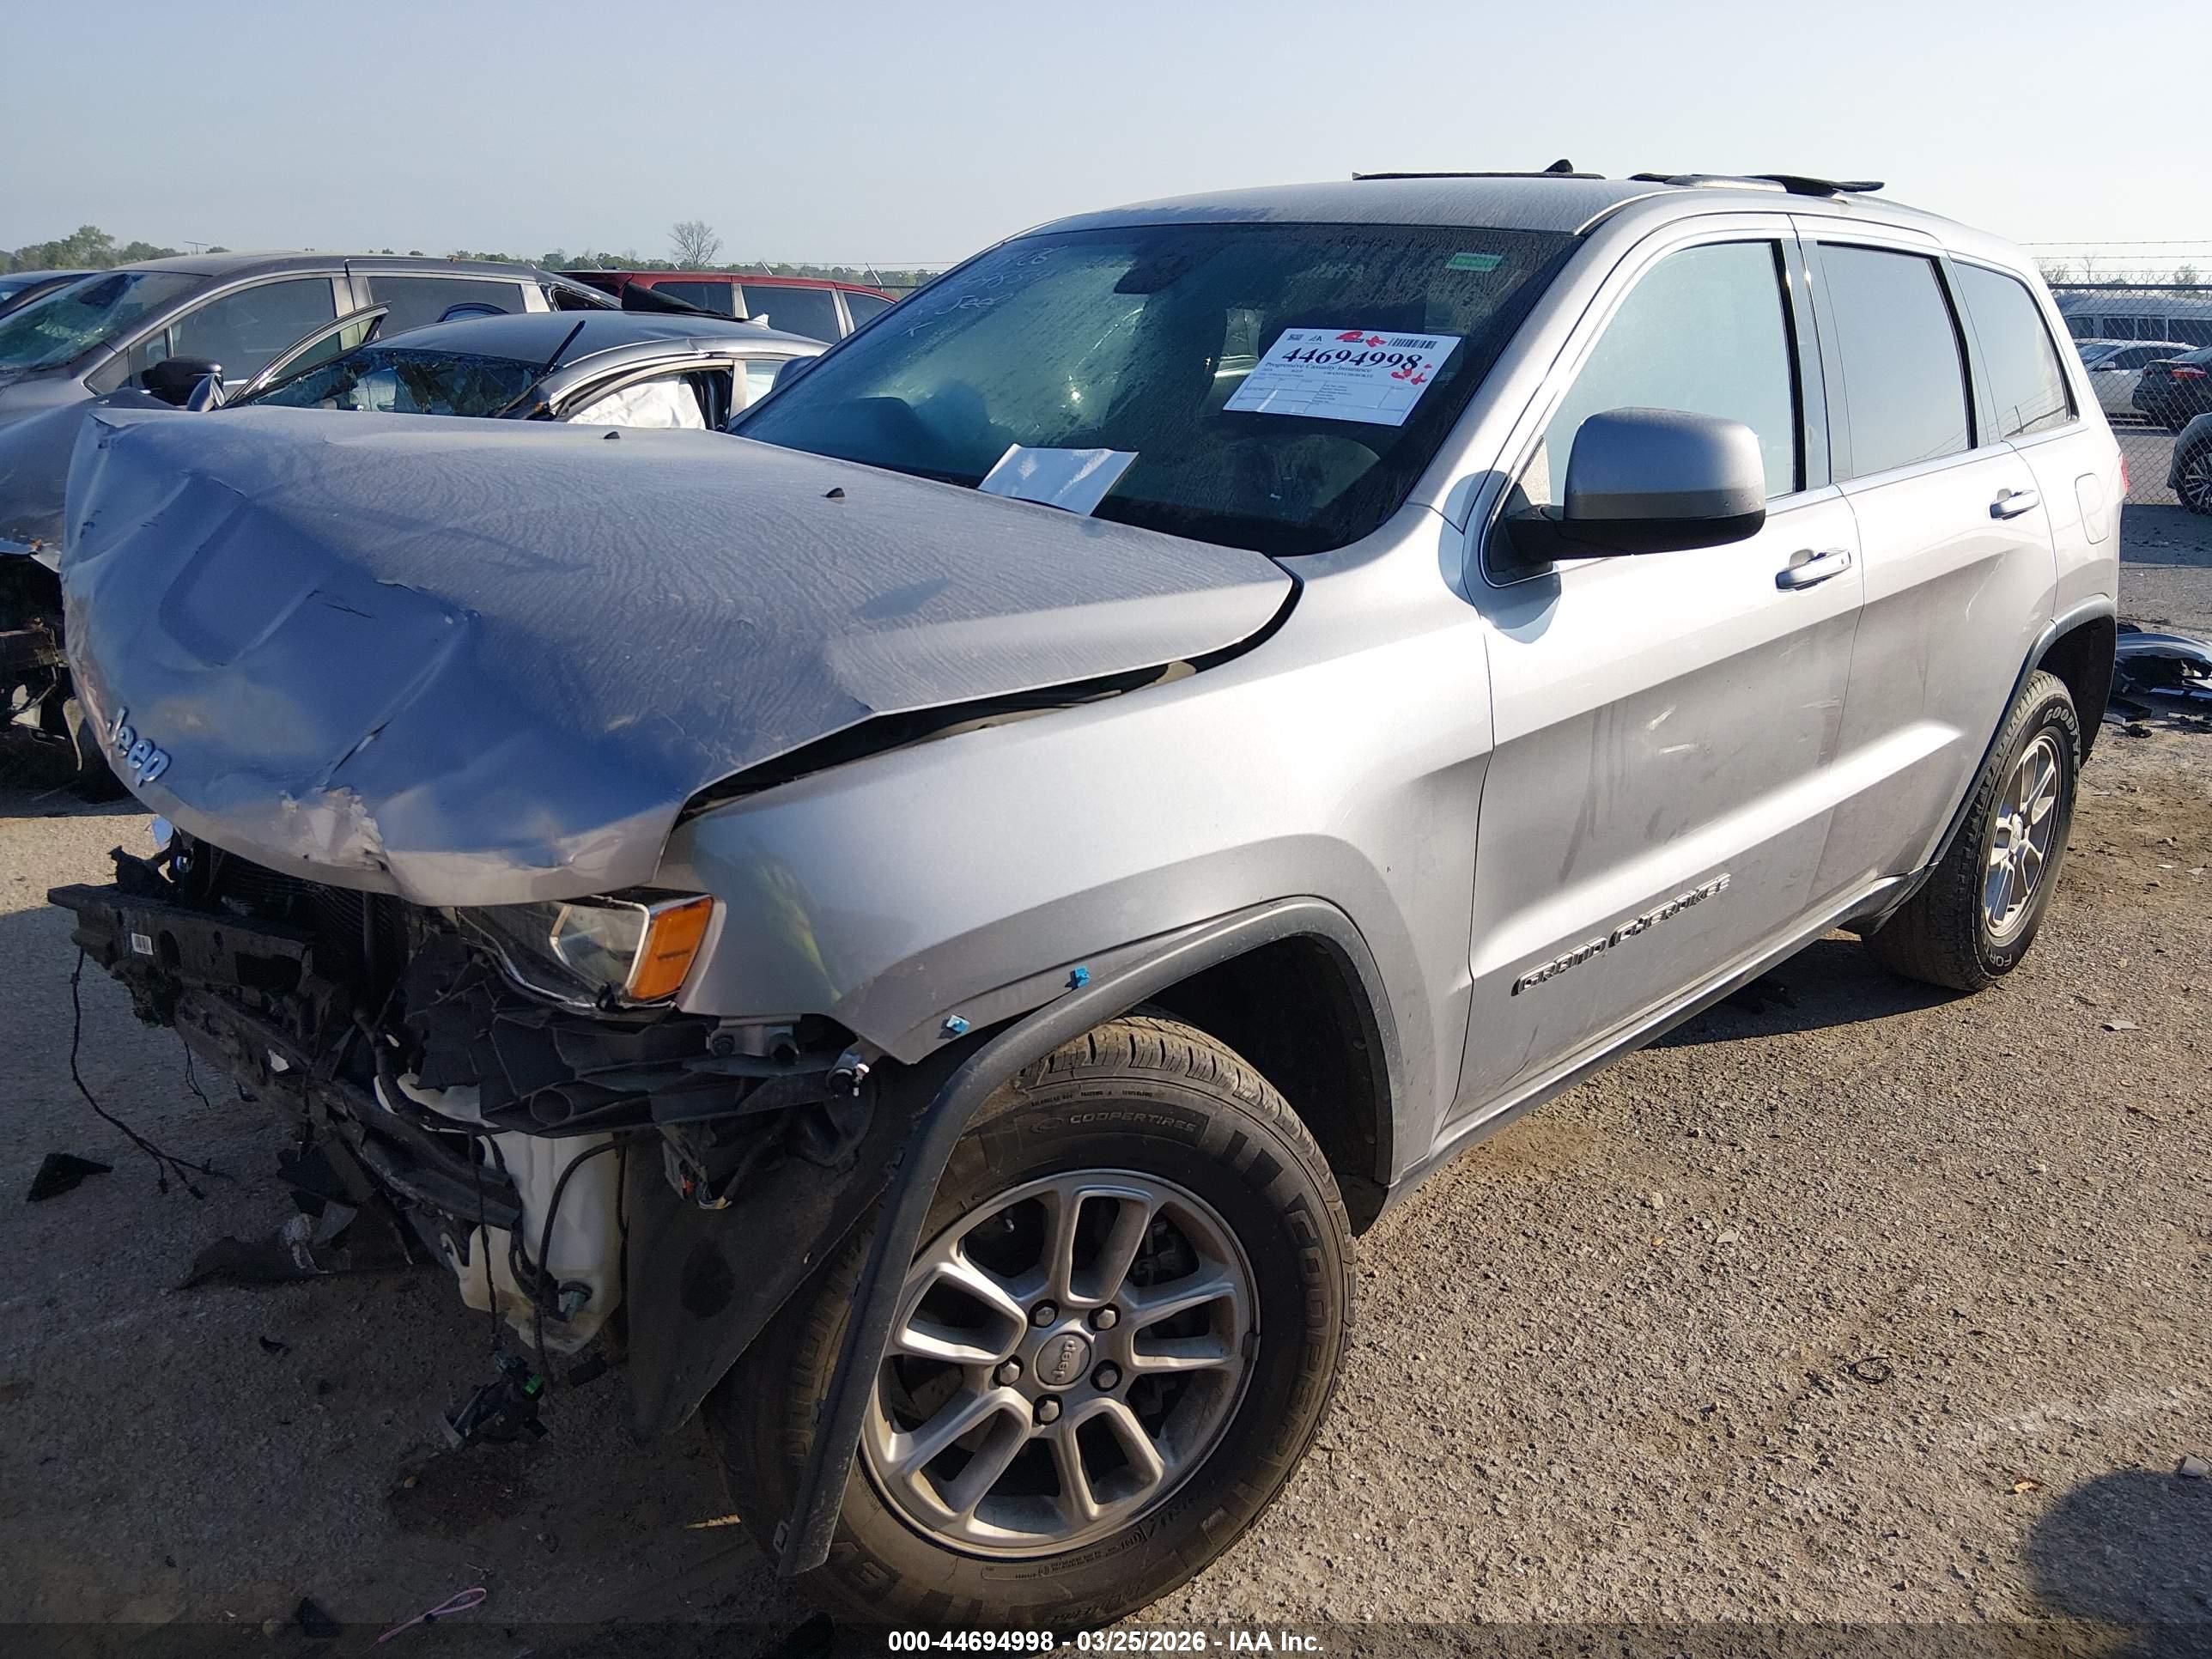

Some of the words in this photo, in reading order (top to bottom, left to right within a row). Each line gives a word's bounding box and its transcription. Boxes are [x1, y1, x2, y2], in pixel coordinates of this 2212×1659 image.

[1282, 347, 1423, 370] 44694998
[106, 708, 170, 785] Jeep
[1511, 937, 1607, 996] GRAND
[1608, 872, 1731, 948] CHEROKEE
